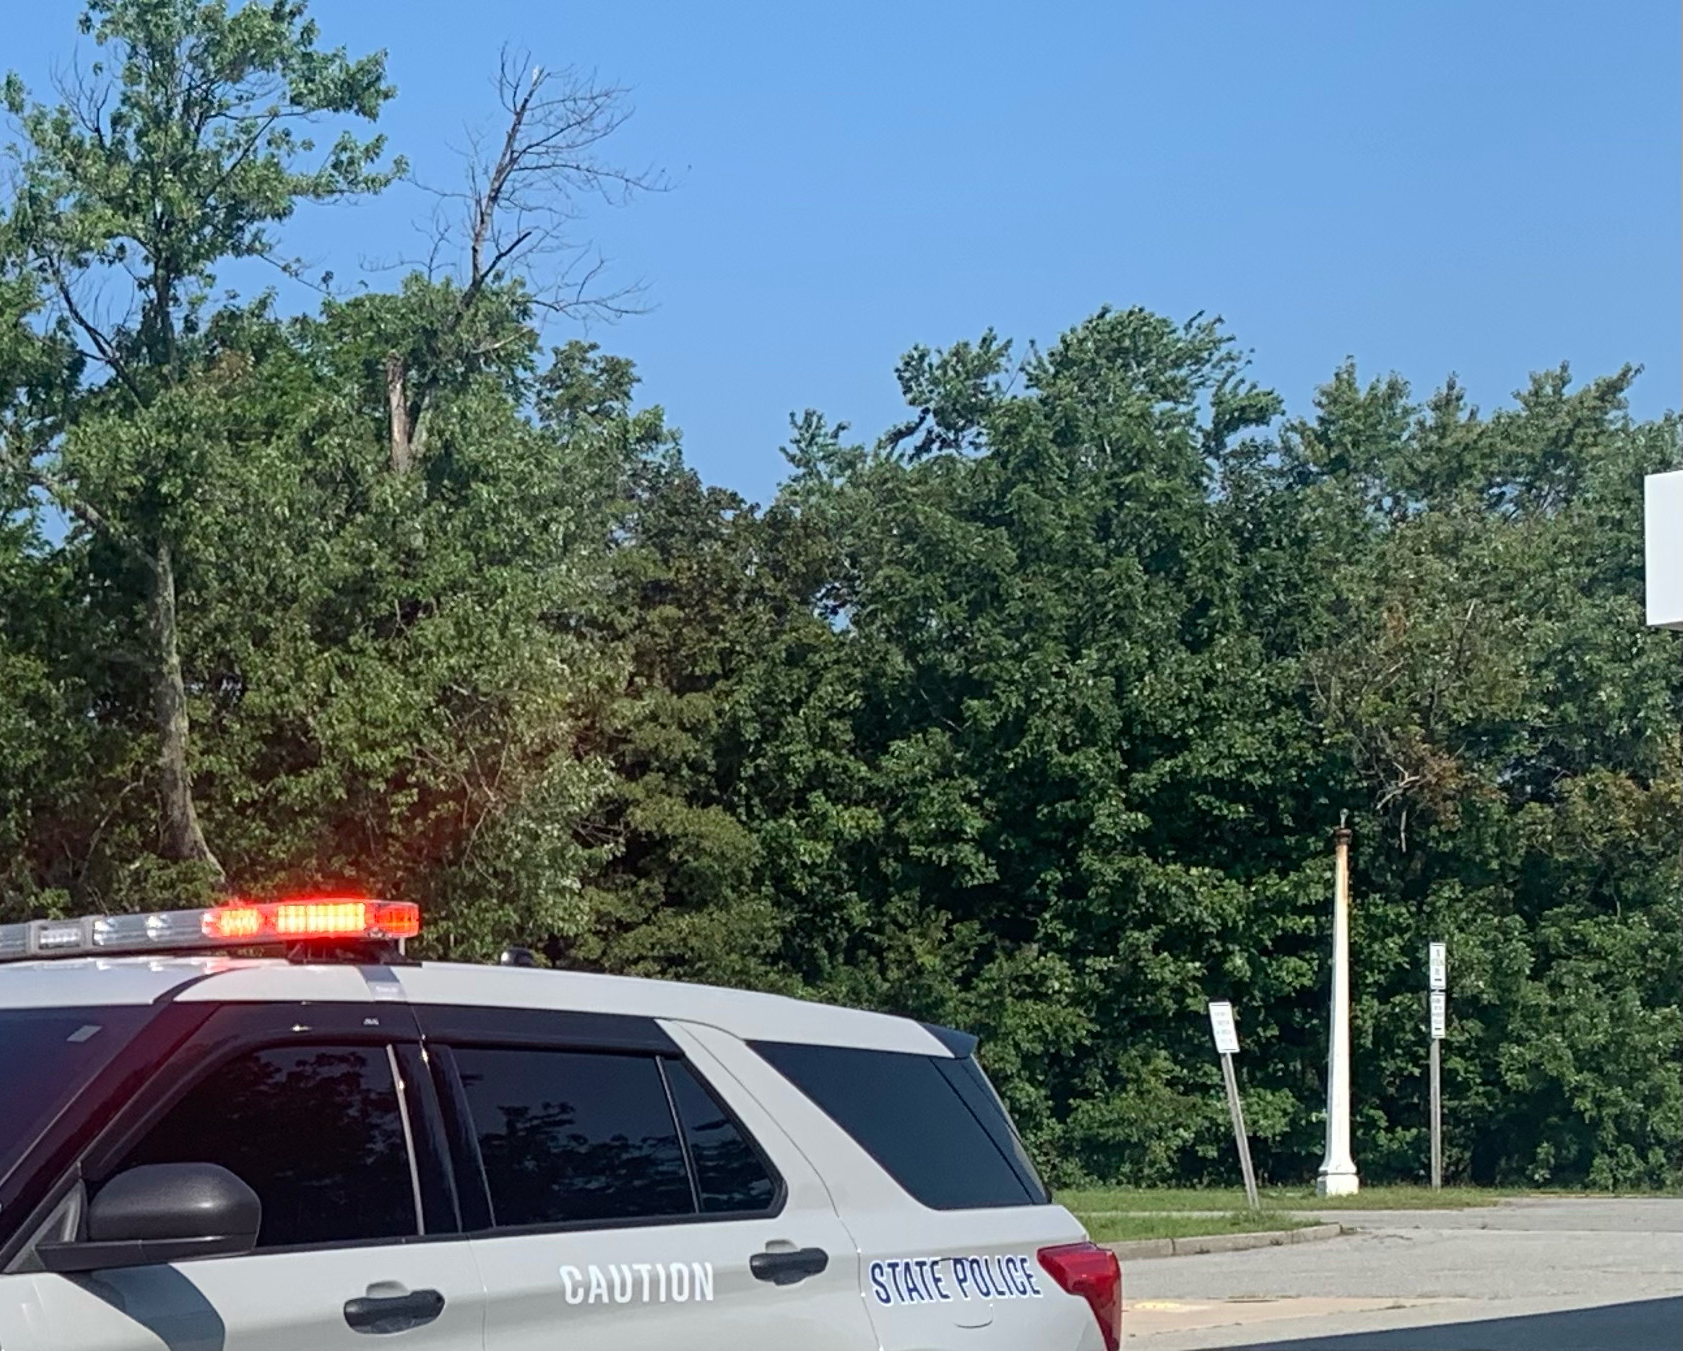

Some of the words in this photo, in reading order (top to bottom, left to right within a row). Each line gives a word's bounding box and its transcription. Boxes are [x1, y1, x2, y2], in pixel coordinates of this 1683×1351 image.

[559, 1261, 714, 1304] CAUTION
[870, 1258, 951, 1305] STATE
[953, 1256, 1042, 1299] POLICE
